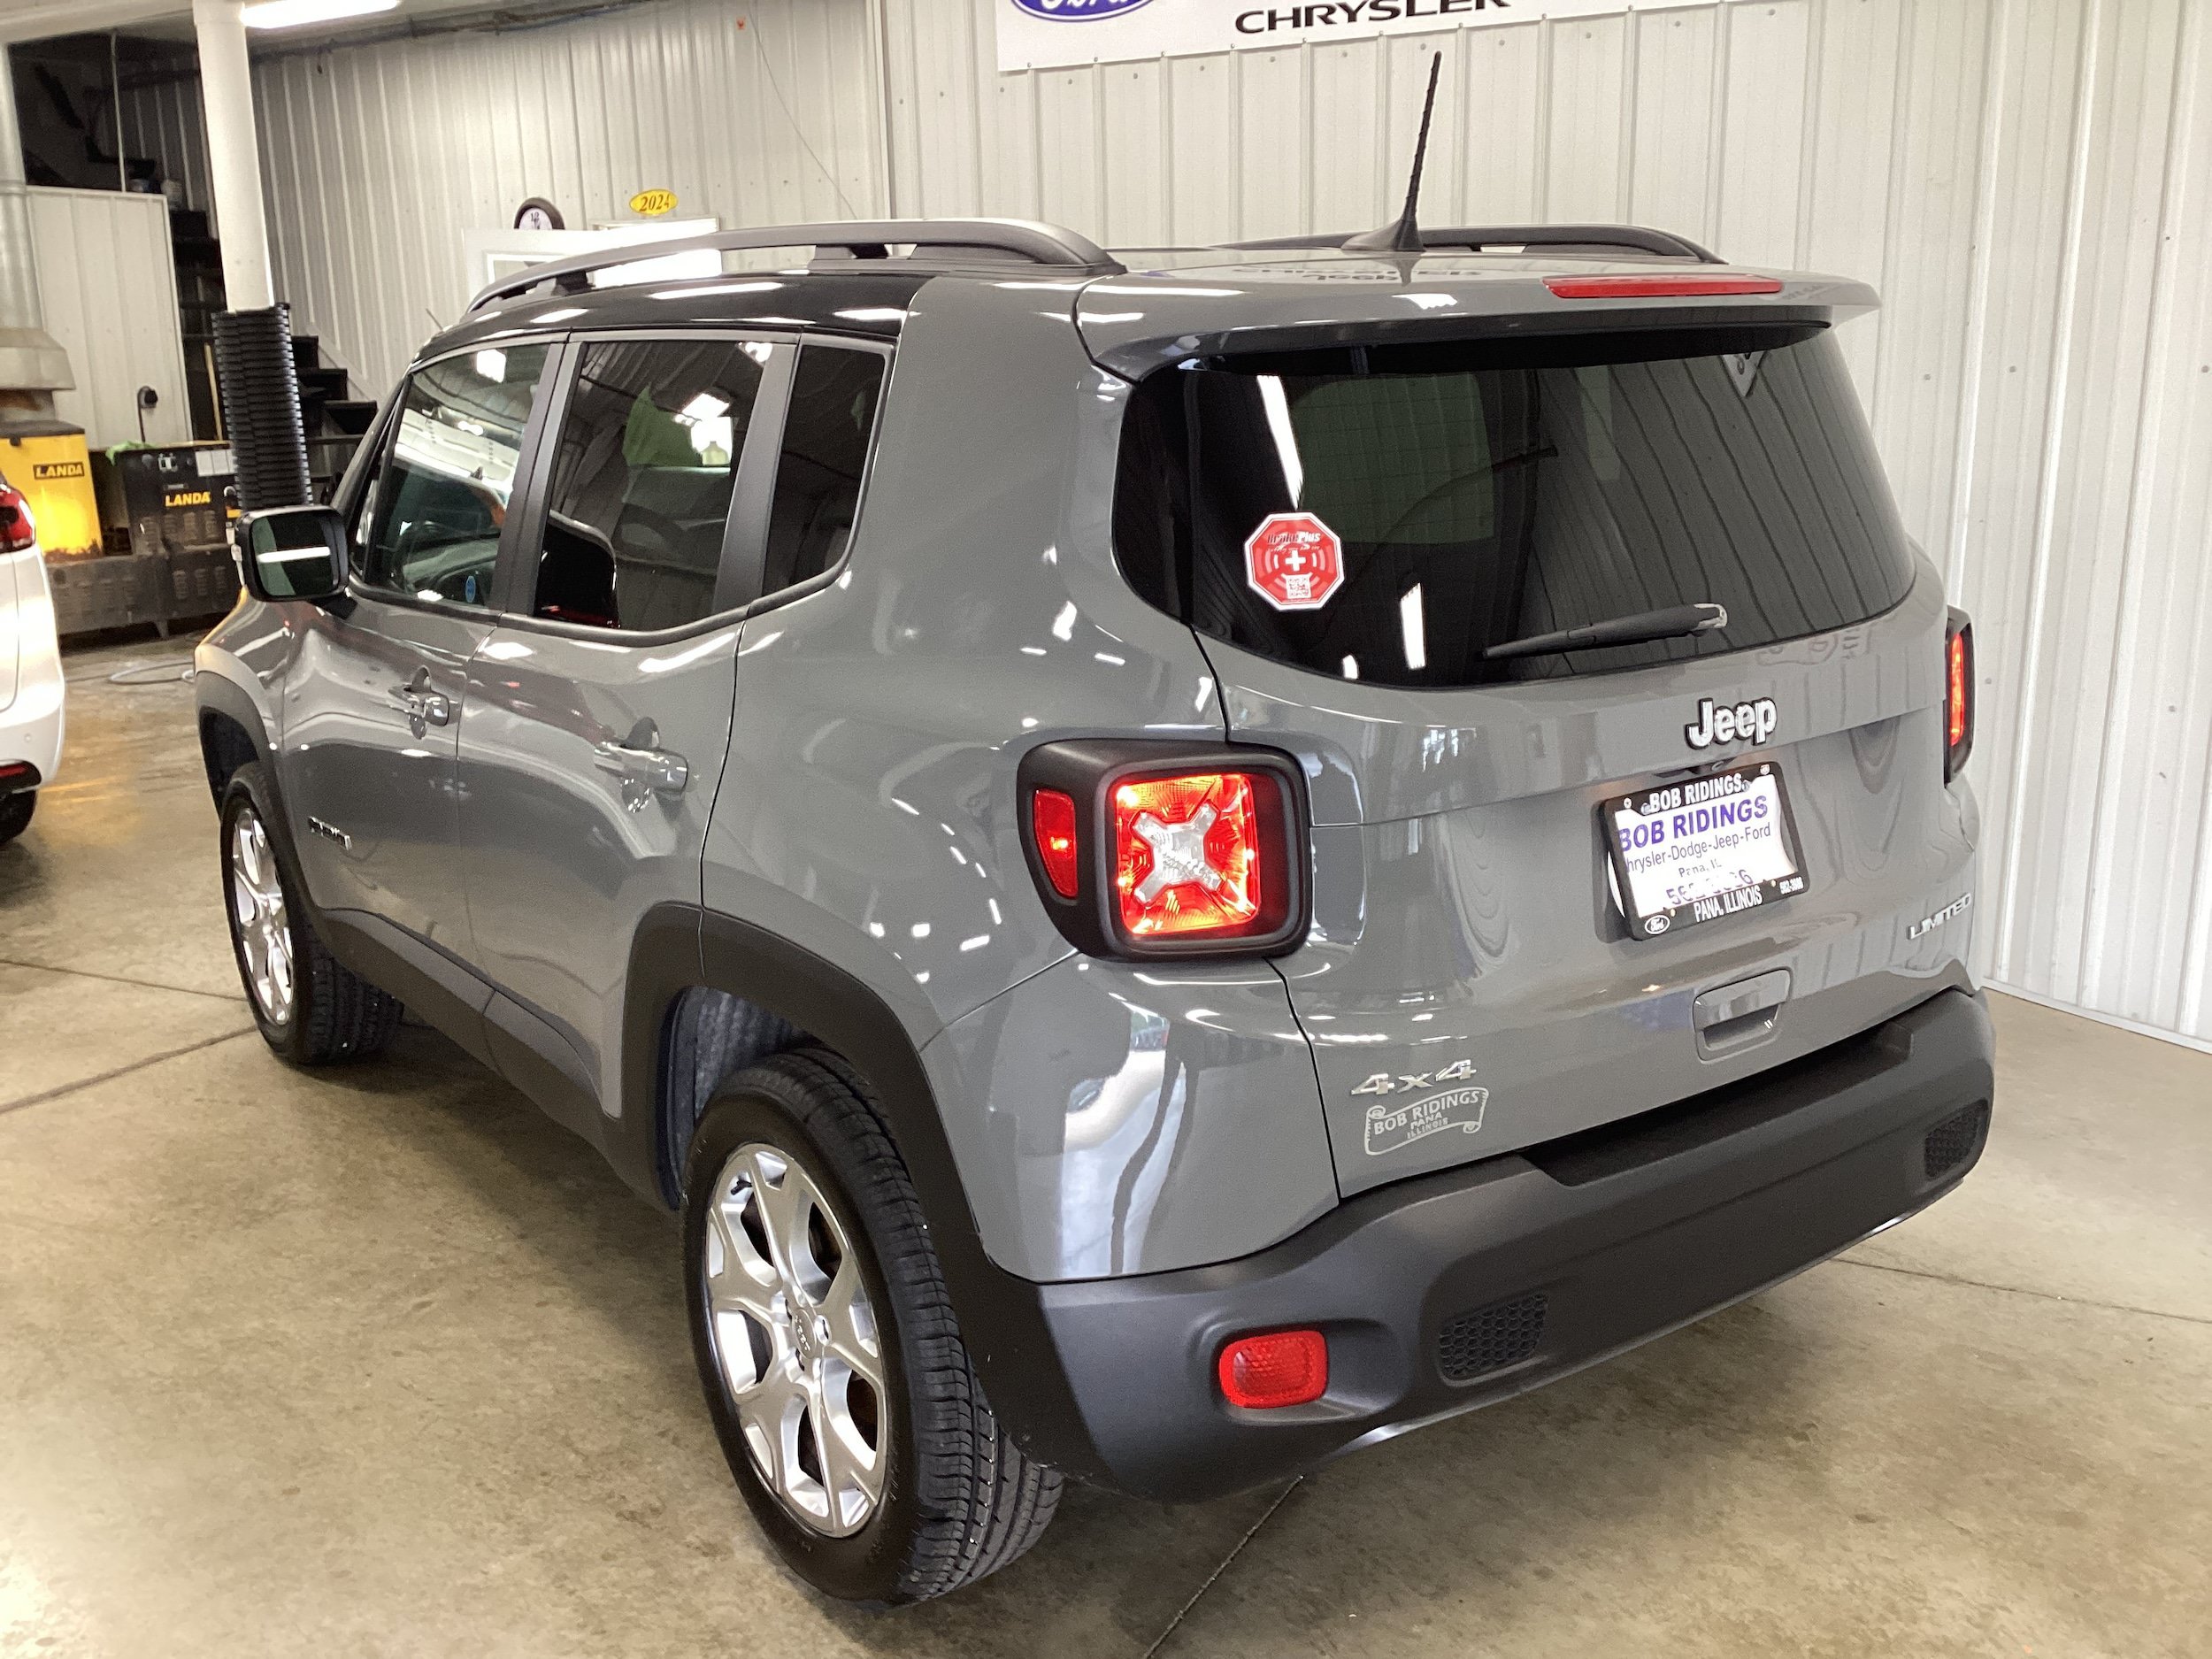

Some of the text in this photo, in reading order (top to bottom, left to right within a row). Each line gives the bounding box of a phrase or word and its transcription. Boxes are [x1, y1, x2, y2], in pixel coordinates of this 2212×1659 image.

[640, 193, 671, 212] 2024
[35, 465, 84, 478] LANDA
[165, 491, 211, 507] LANDA
[1685, 697, 1778, 749] Jeep
[1648, 772, 1742, 814] BOB RIDINGS
[1619, 795, 1769, 852] BOB RIDINGS
[1723, 885, 1763, 914] ILLINOIS
[1906, 892, 1972, 940] LIMITED
[1373, 1090, 1481, 1135] BOB RIDINGS
[1409, 1111, 1443, 1130] PANA
[1407, 1118, 1449, 1139] ILLINOIS
